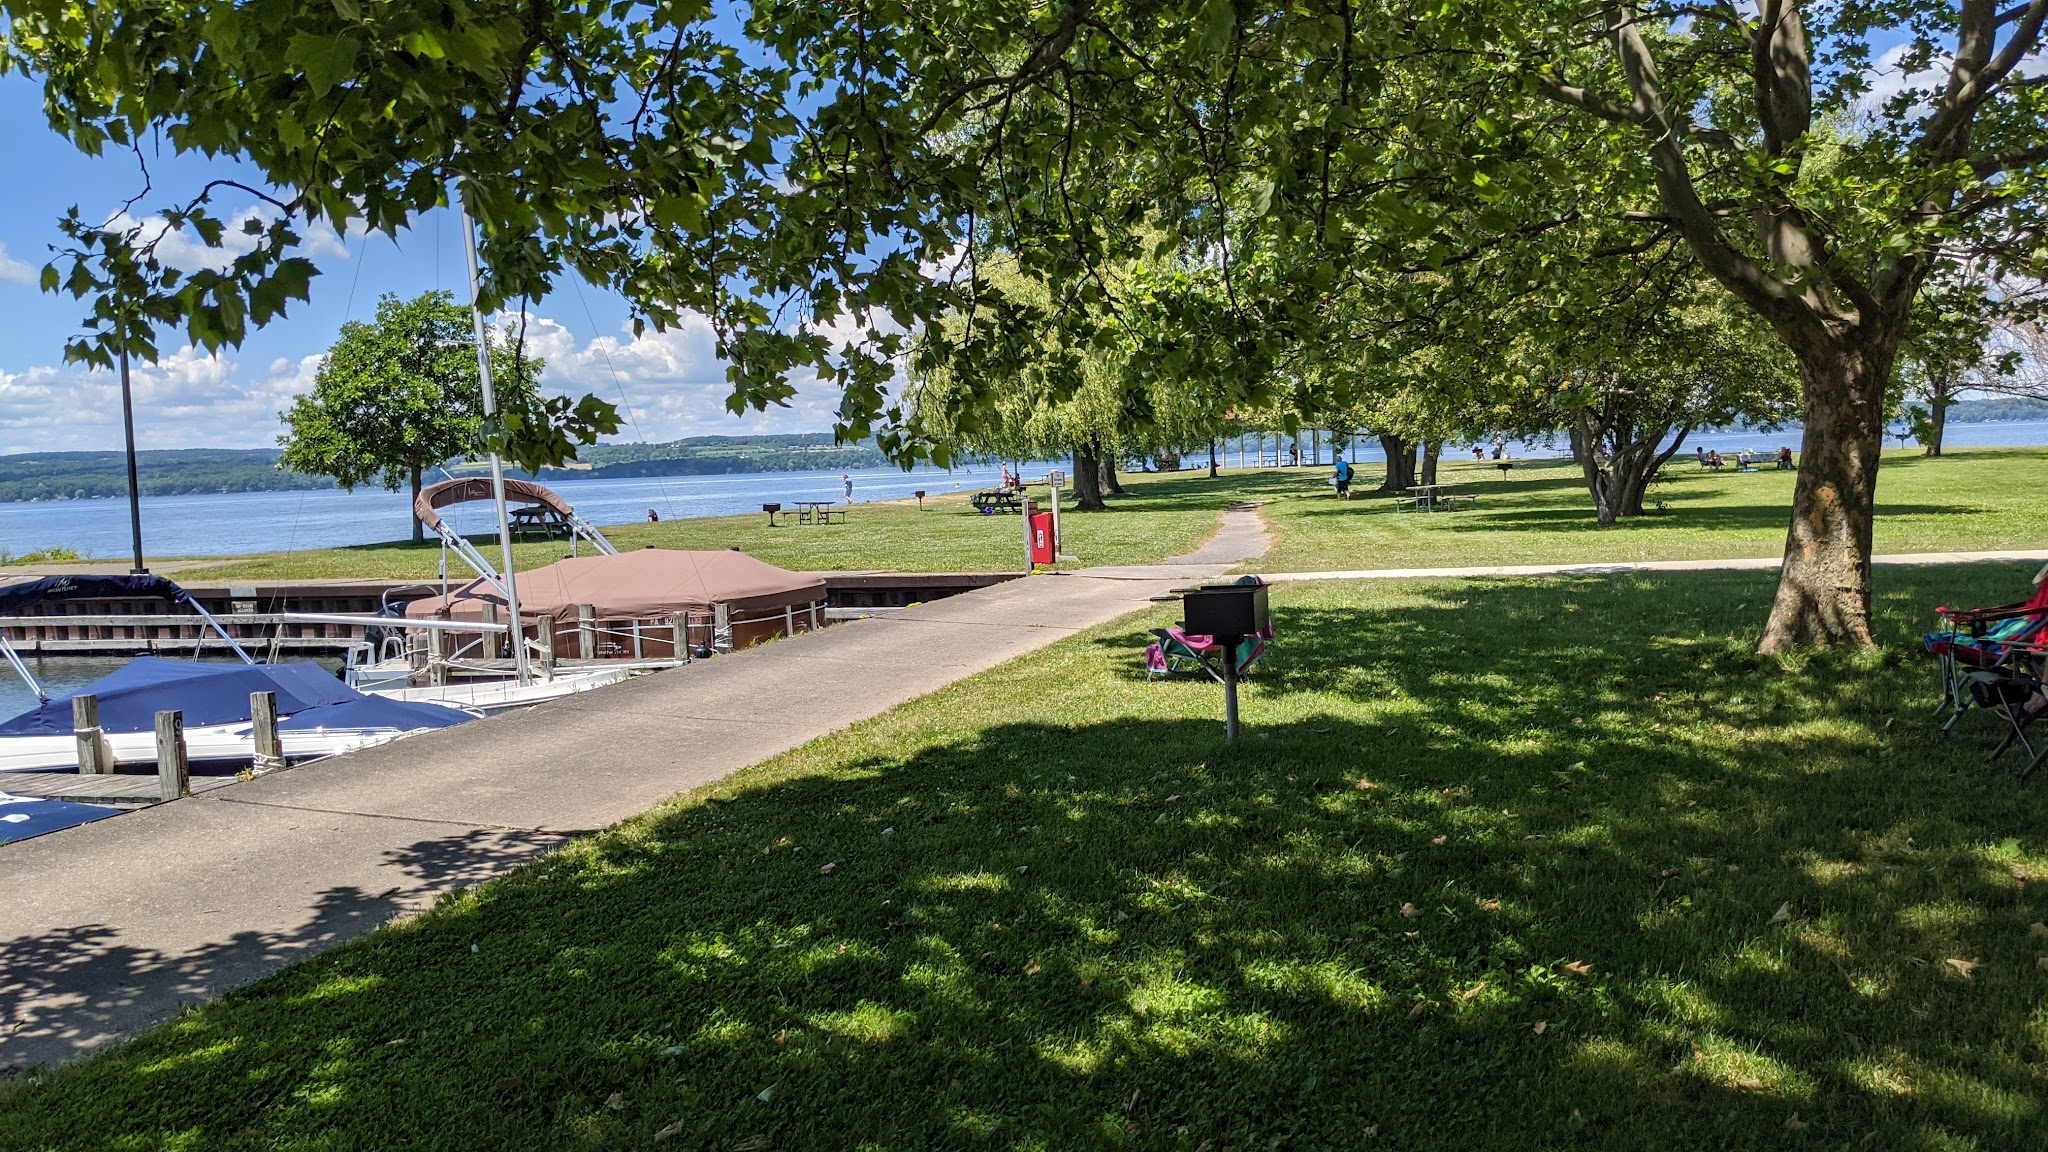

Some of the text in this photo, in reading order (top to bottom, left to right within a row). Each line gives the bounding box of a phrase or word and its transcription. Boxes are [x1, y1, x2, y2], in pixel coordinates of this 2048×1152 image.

[47, 585, 79, 593] MONTEREY
[650, 618, 659, 626] PA
[175, 718, 182, 736] 9
